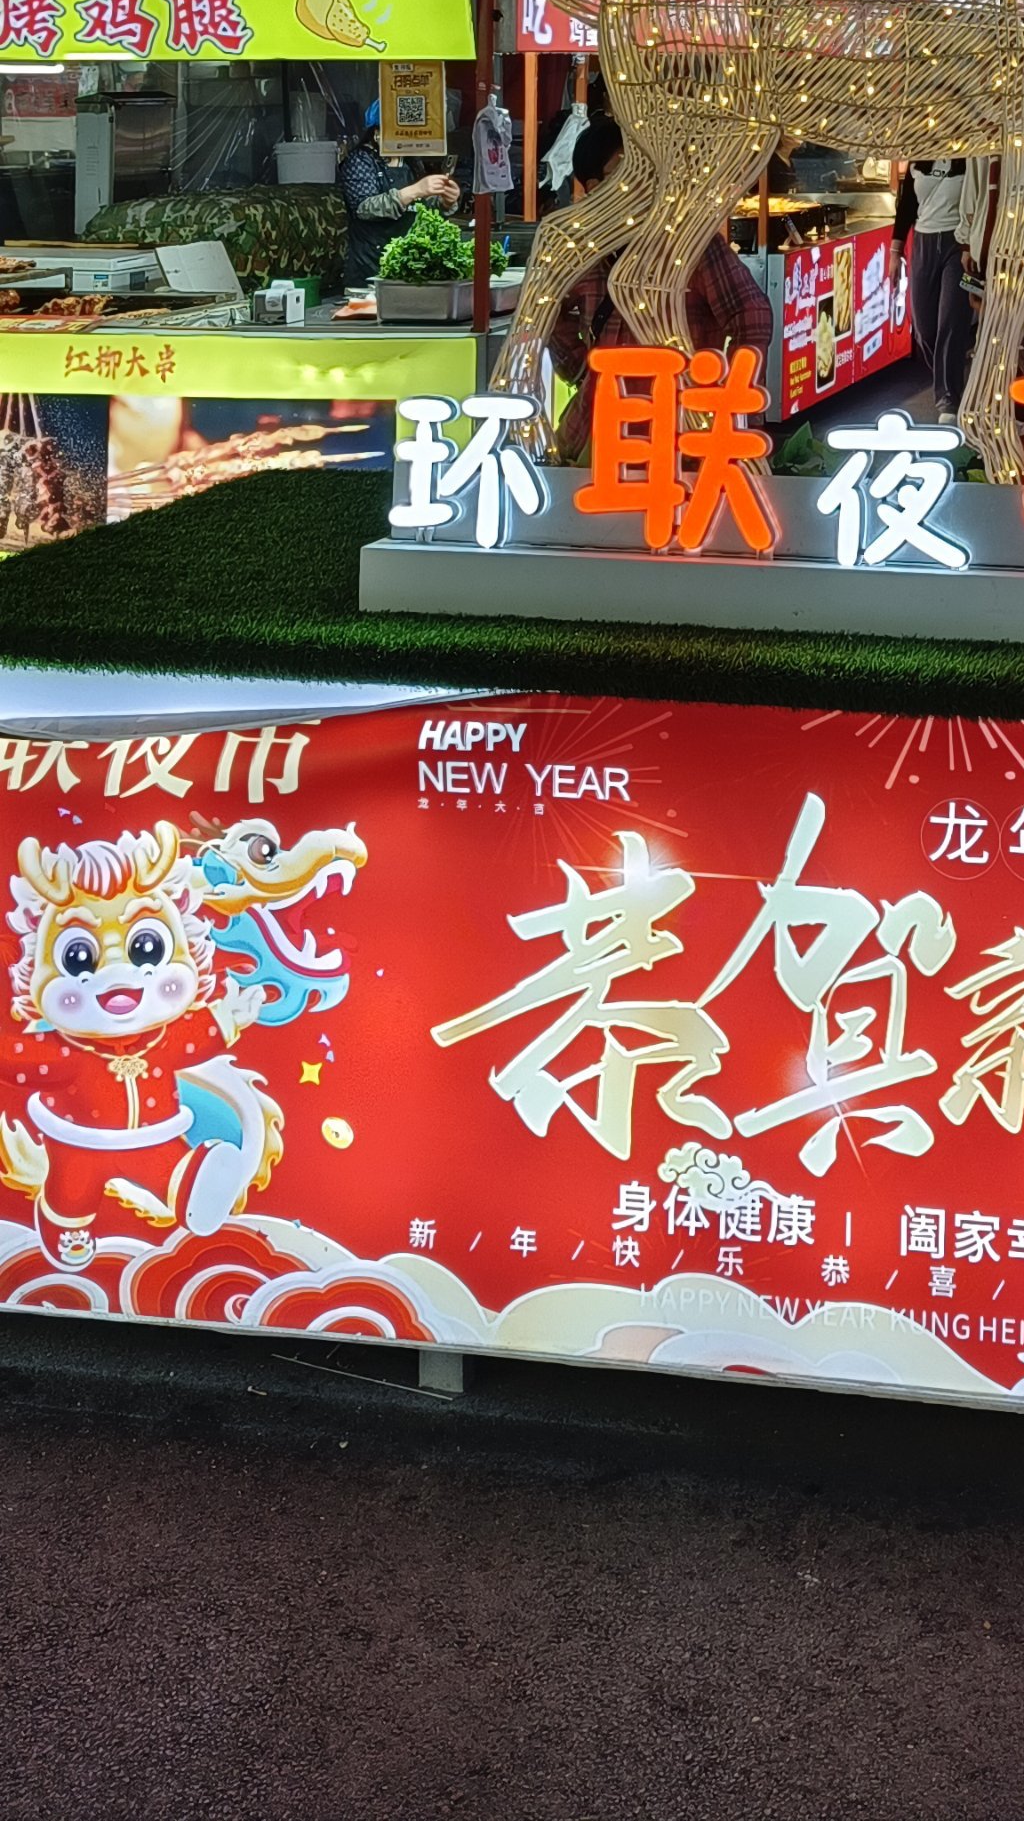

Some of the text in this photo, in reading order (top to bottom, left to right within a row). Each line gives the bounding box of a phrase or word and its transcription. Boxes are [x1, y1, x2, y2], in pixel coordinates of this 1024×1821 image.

[64, 344, 177, 383] 红柳大串
[418, 720, 527, 753] HAPPY
[418, 760, 631, 802] NEW YEAR
[611, 1181, 816, 1247] 身体健康
[639, 1283, 730, 1314] HAPPY
[736, 1291, 799, 1324] NEW
[805, 1298, 876, 1330] YEAR
[889, 1306, 971, 1340] KUNG
